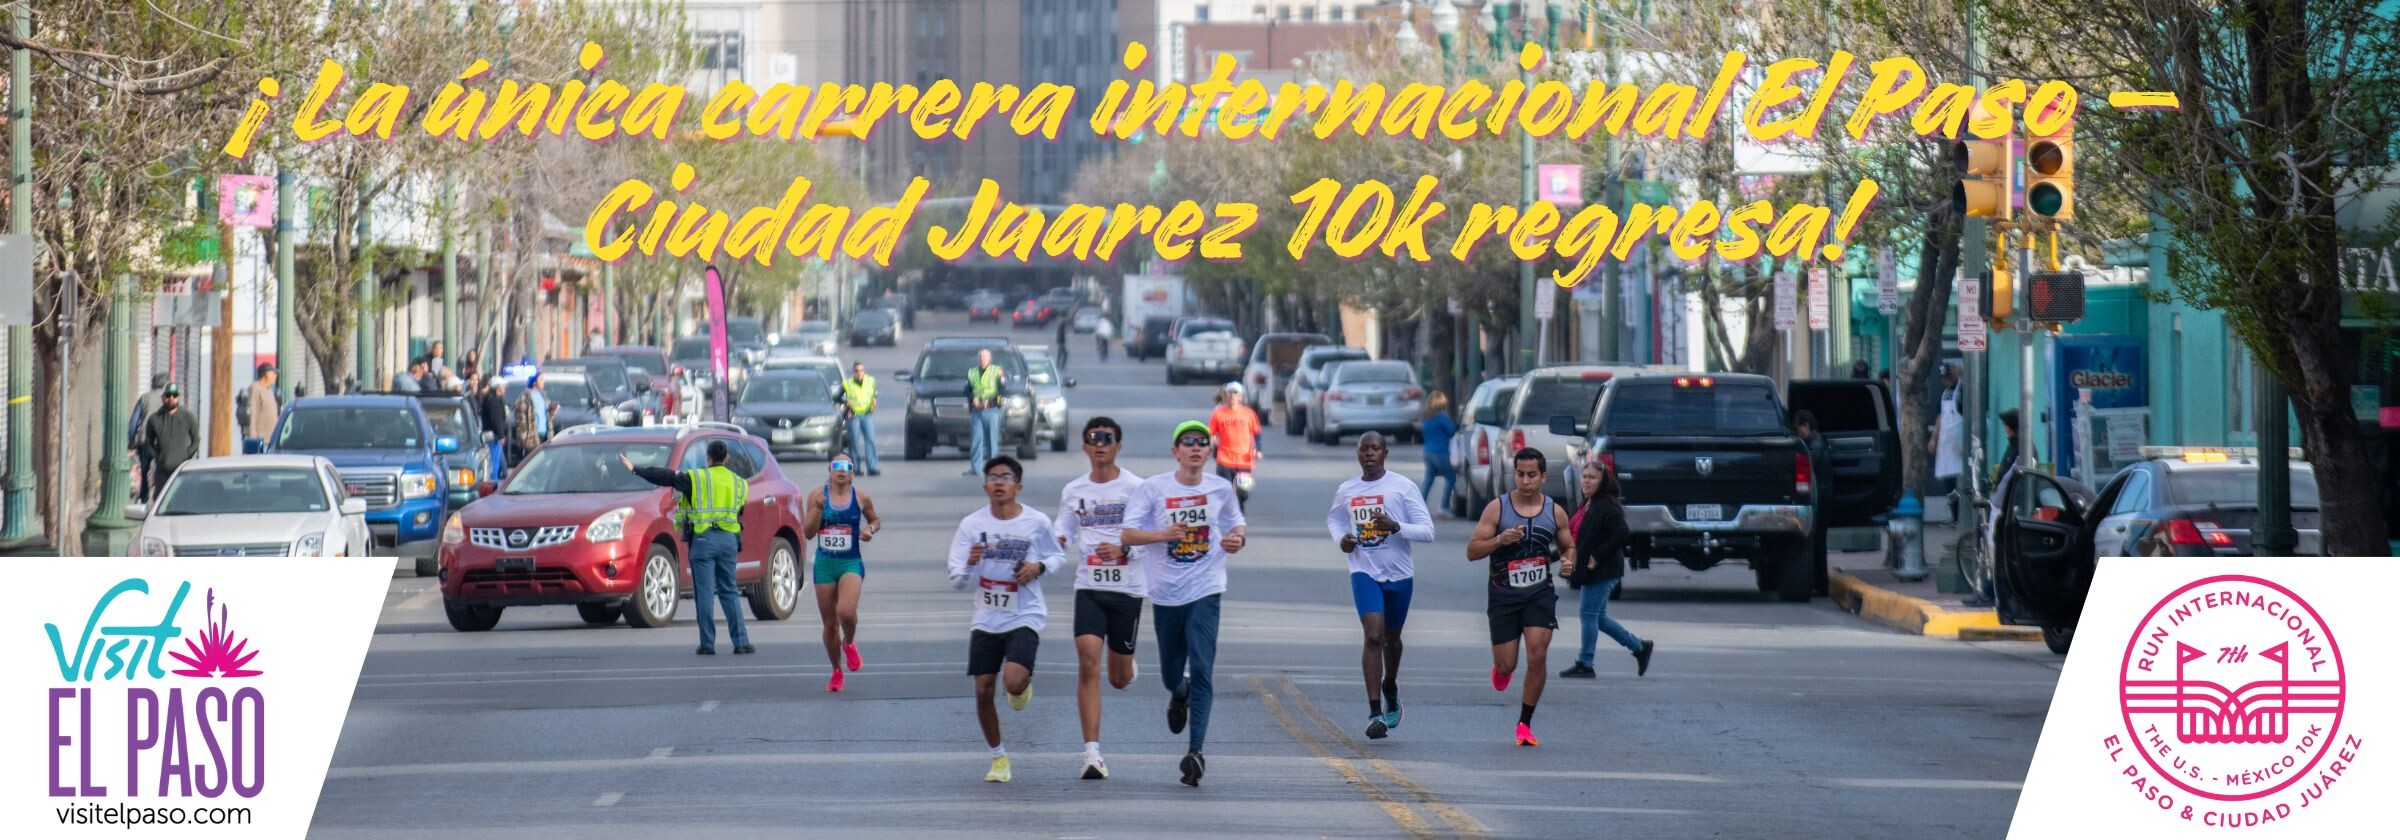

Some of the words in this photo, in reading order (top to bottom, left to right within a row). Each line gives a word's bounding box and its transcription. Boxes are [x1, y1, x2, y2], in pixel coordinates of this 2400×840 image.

[2070, 370, 2132, 388] Glacier
[1169, 508, 1207, 524] 1294
[824, 536, 846, 547] 523
[1094, 568, 1121, 582] 518
[1512, 568, 1544, 584] 1707
[984, 592, 1010, 607] 517
